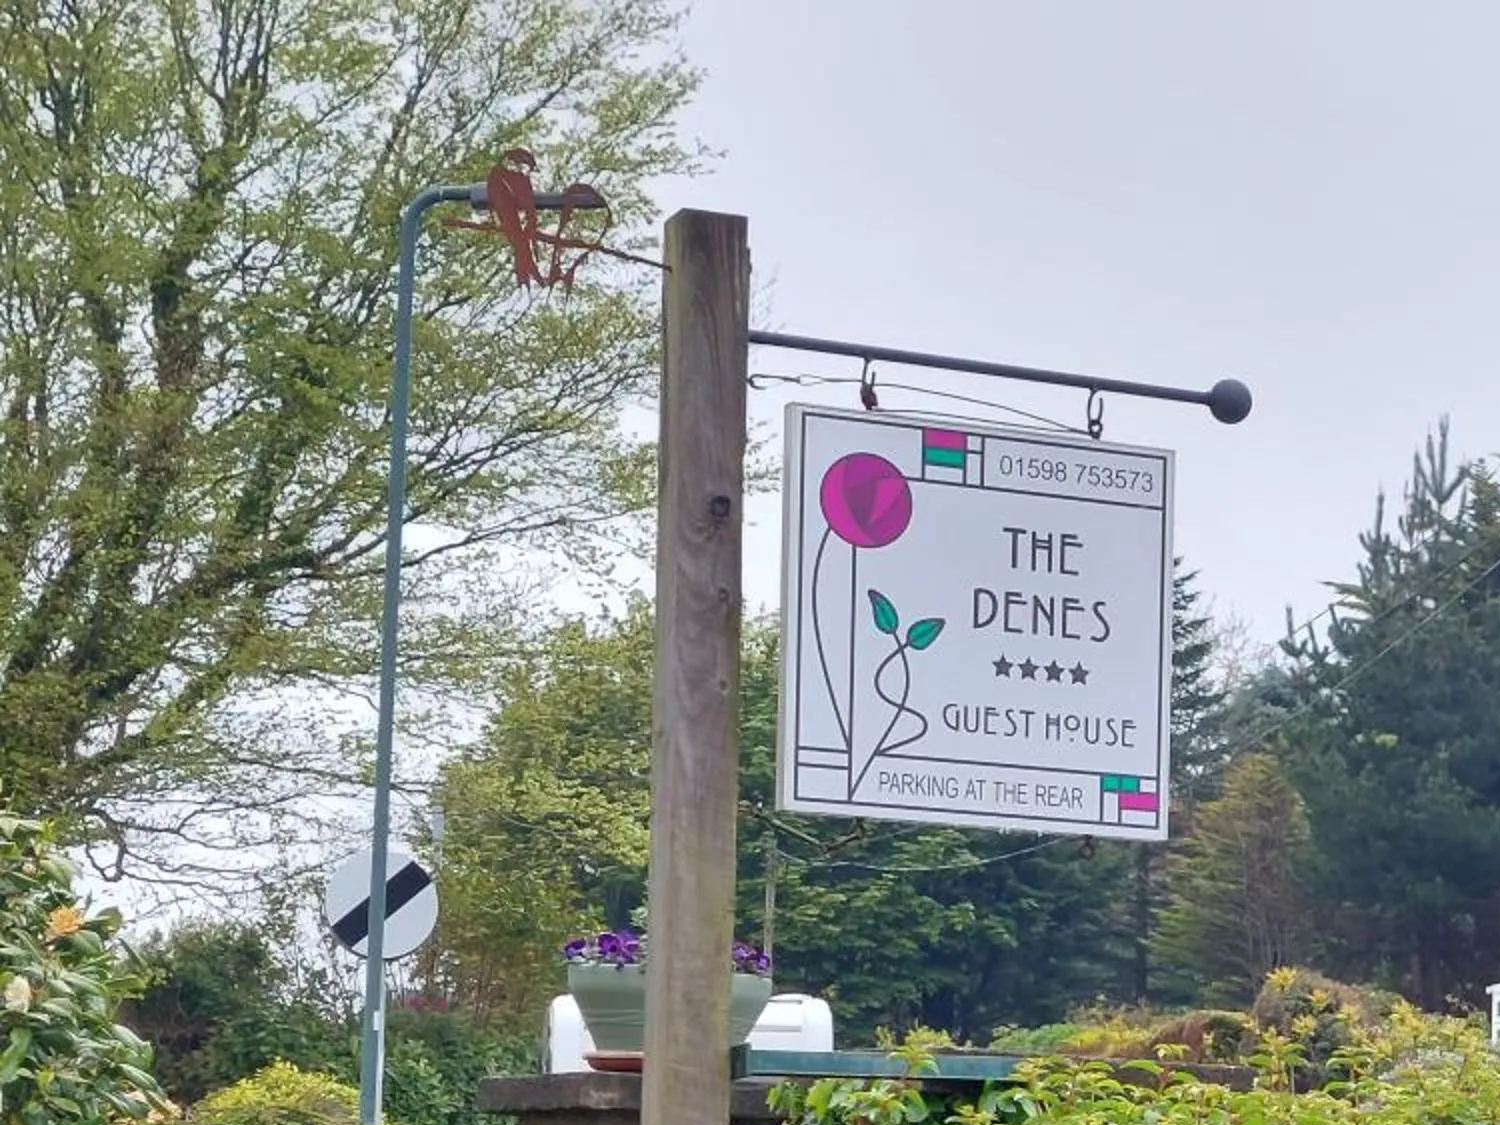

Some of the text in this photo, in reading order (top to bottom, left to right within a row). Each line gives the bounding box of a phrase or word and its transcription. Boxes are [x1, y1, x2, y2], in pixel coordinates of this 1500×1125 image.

[999, 455, 1154, 493] 01598 753573
[1002, 526, 1084, 576] THE
[972, 588, 1111, 643] DENES
[942, 703, 1137, 748] GUEST HOUSE
[878, 771, 1083, 809] PARKING AT THE REAR
